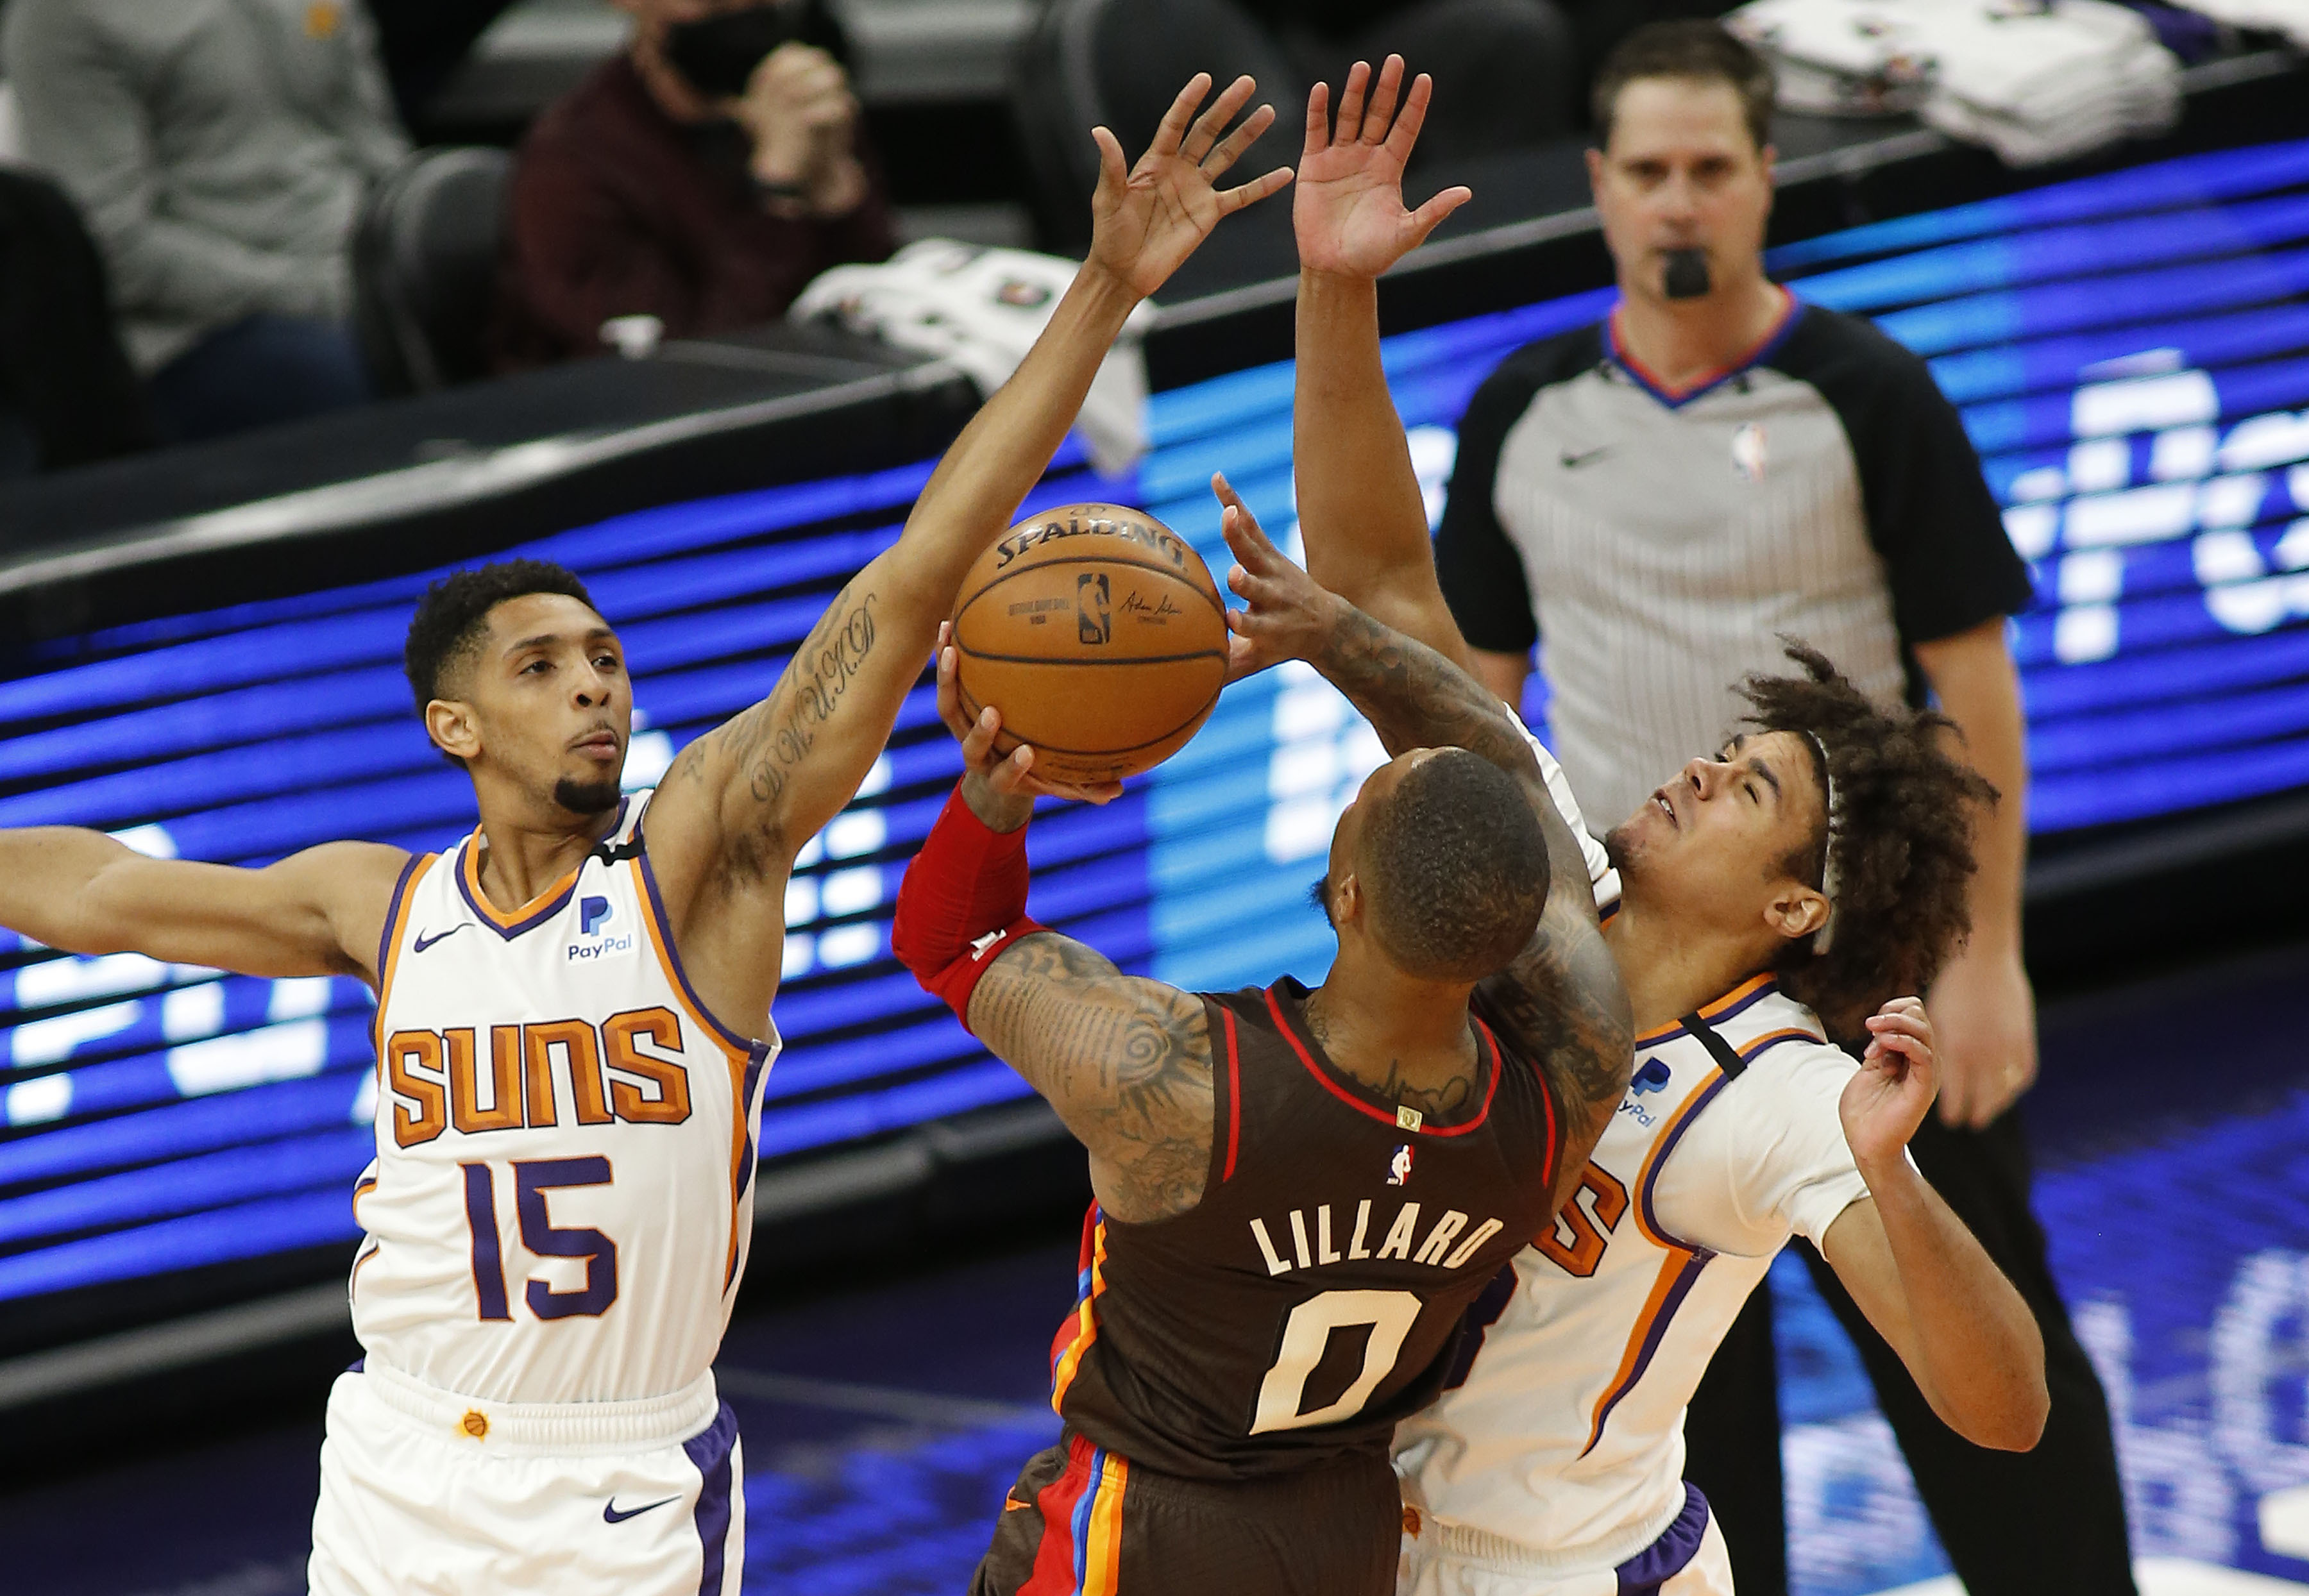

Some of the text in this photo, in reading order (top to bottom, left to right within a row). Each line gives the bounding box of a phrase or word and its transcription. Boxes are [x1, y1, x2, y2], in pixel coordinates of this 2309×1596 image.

[997, 517, 1184, 569] SPALDING
[568, 933, 632, 960] PayPal
[1617, 1099, 1656, 1127] yPal
[456, 1155, 619, 1323] 15
[1249, 1198, 1504, 1277] LILLARD
[1249, 1289, 1423, 1436] 0
